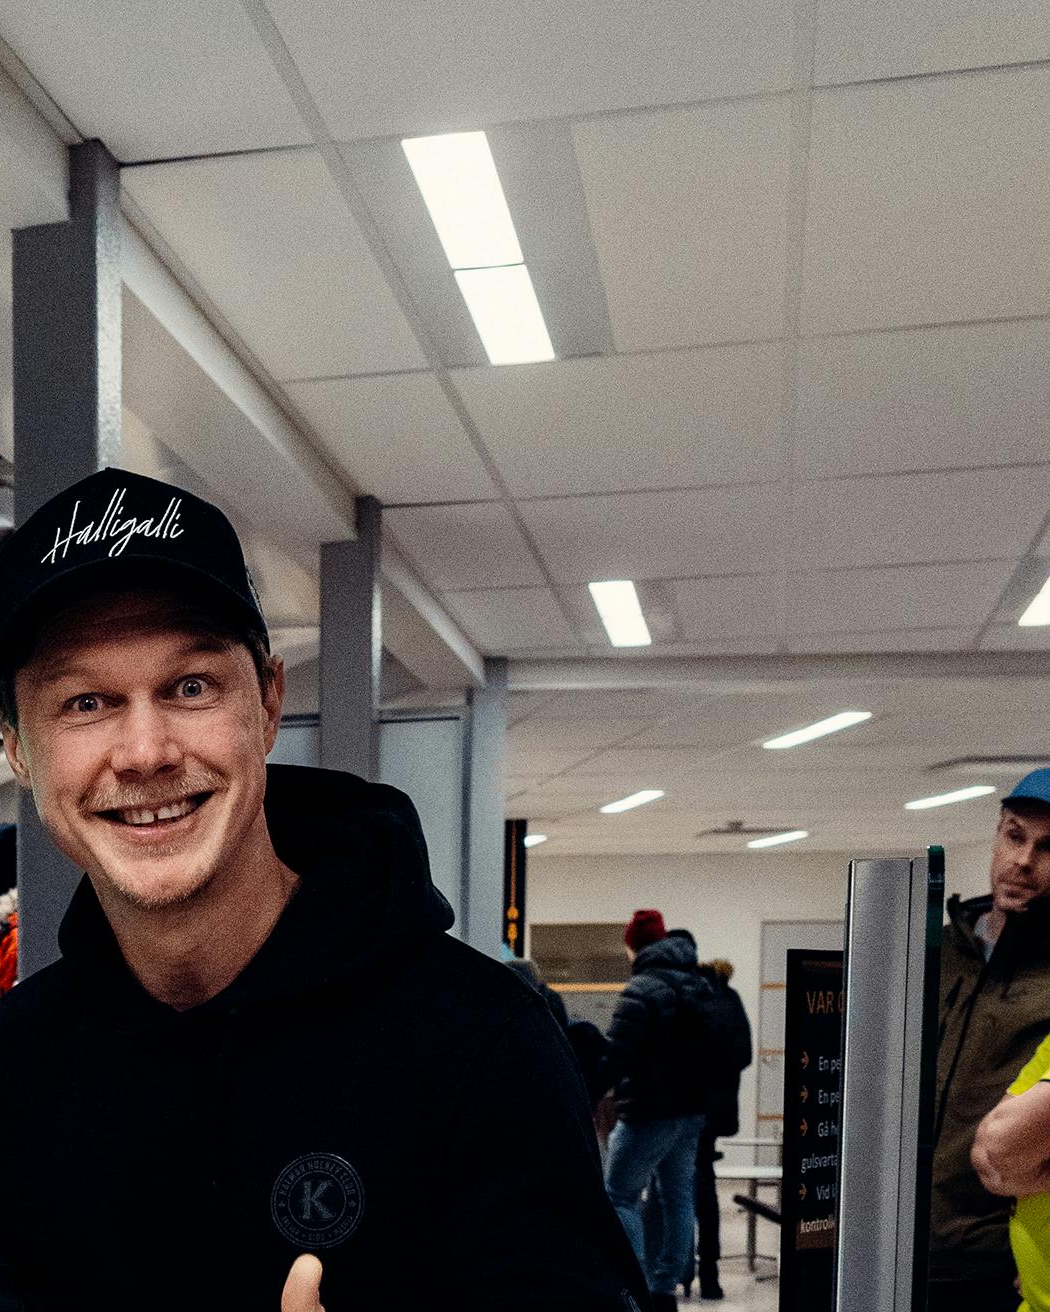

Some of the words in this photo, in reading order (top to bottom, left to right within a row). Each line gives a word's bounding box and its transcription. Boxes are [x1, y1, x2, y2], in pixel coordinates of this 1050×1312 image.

[41, 487, 185, 564] Halligalli
[806, 990, 835, 1014] VAR
[818, 1056, 829, 1071] En
[817, 1089, 828, 1105] En
[817, 1119, 829, 1138] Gå
[302, 1180, 335, 1219] K
